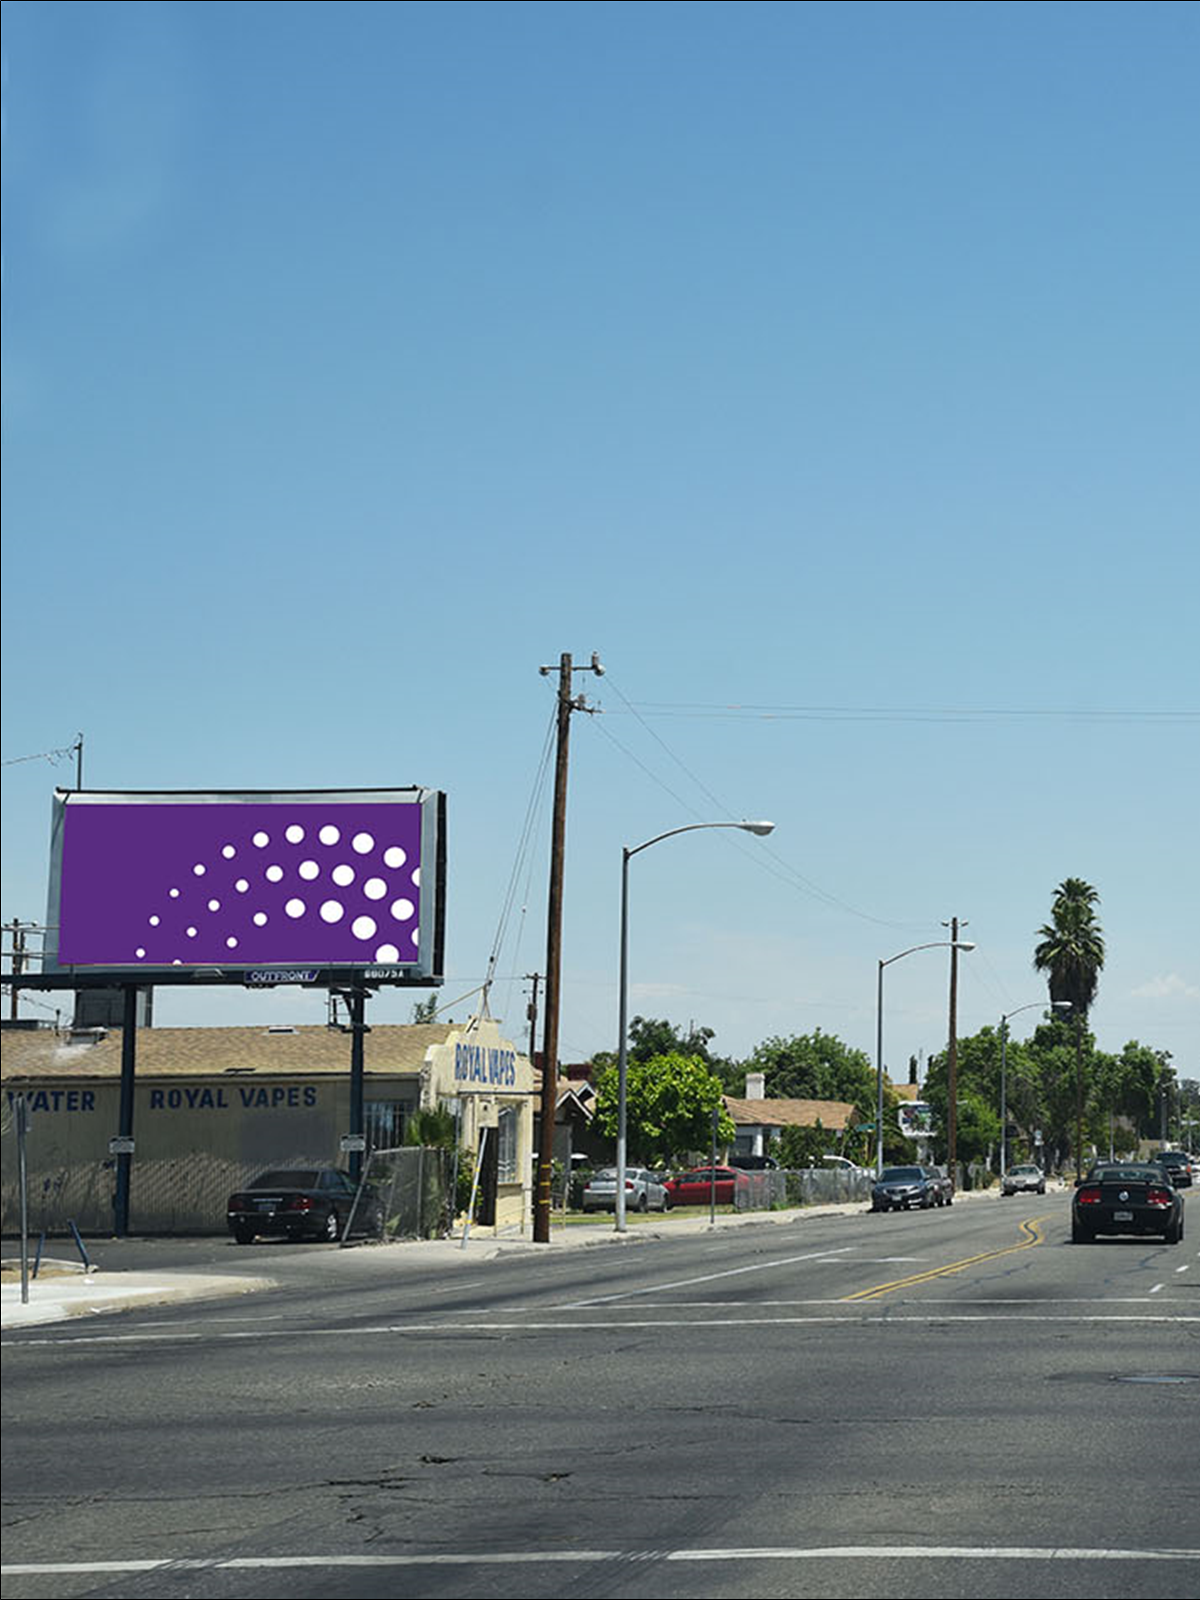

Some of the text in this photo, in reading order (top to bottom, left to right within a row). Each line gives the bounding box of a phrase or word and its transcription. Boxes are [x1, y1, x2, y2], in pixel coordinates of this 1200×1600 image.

[250, 971, 310, 982] OUTFRONT
[455, 1042, 516, 1087] ROYAL VAPES
[150, 1088, 229, 1110] ROYAL
[239, 1086, 317, 1107] VAPES
